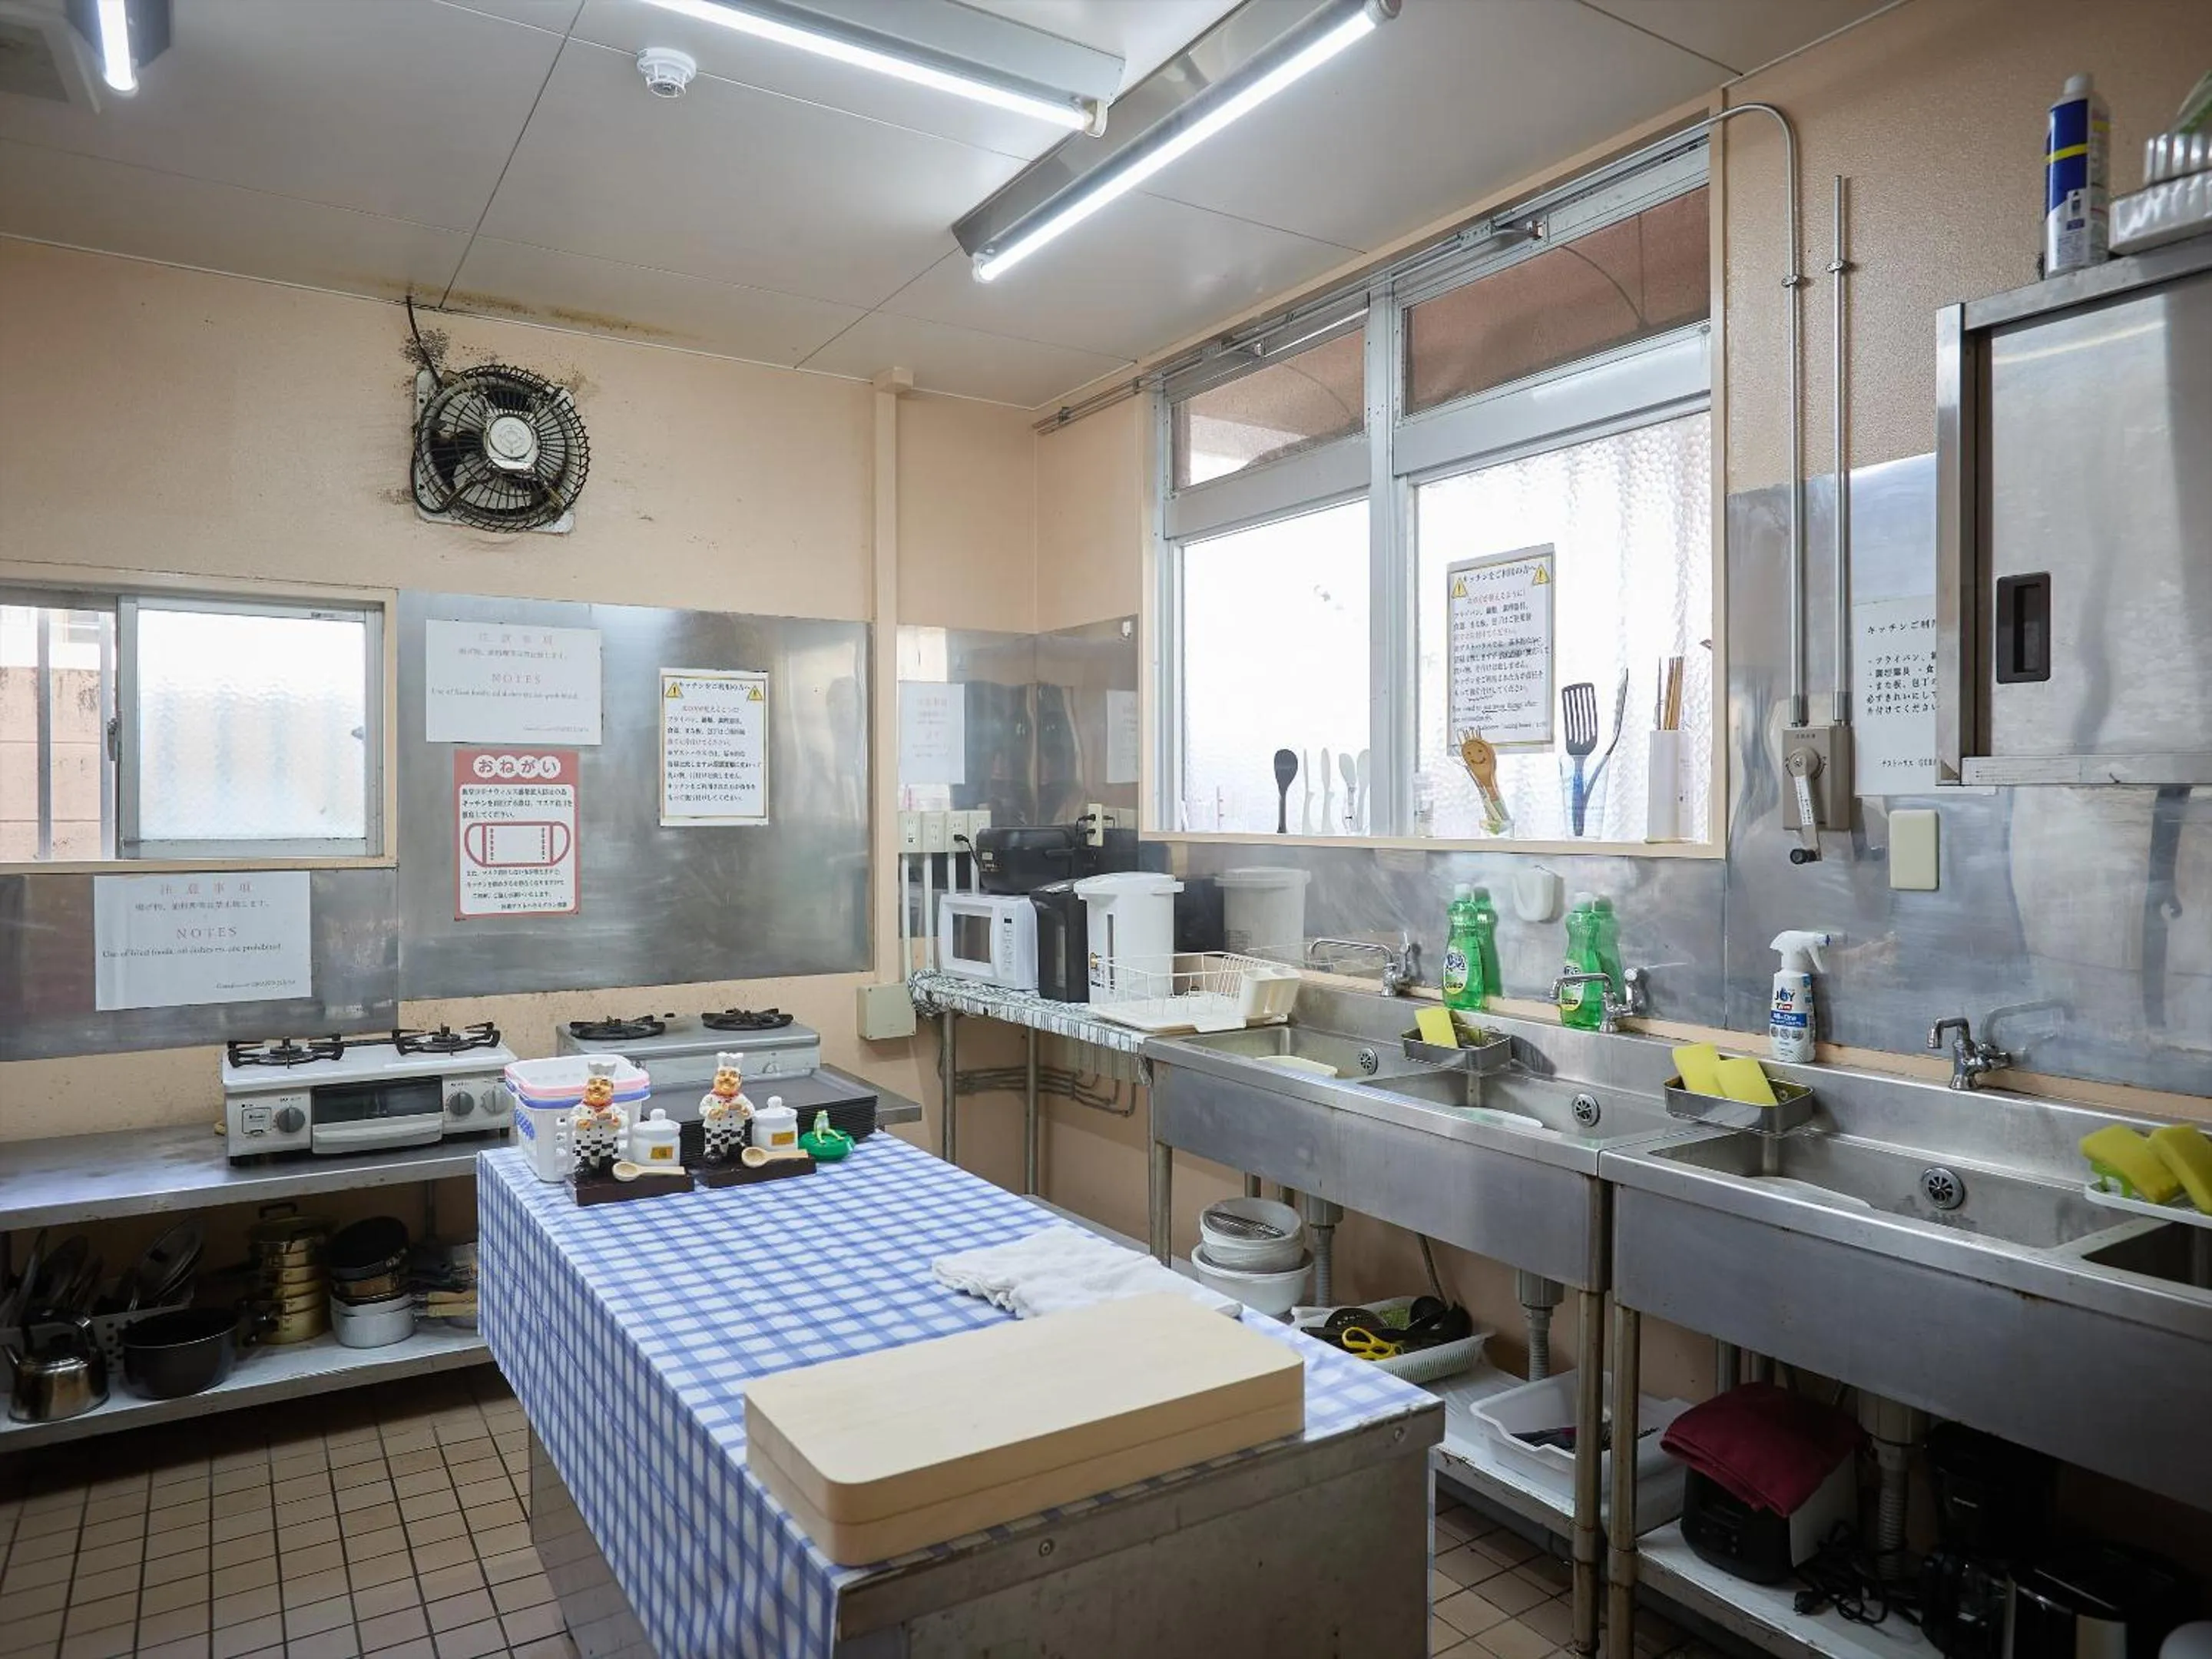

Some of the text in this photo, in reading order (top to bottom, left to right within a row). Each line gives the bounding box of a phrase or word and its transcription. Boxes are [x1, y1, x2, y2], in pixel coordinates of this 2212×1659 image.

[492, 673, 542, 684] NOTES
[478, 760, 557, 773] おねがい
[176, 926, 238, 940] NOTES
[1775, 987, 1795, 1002] JOY
